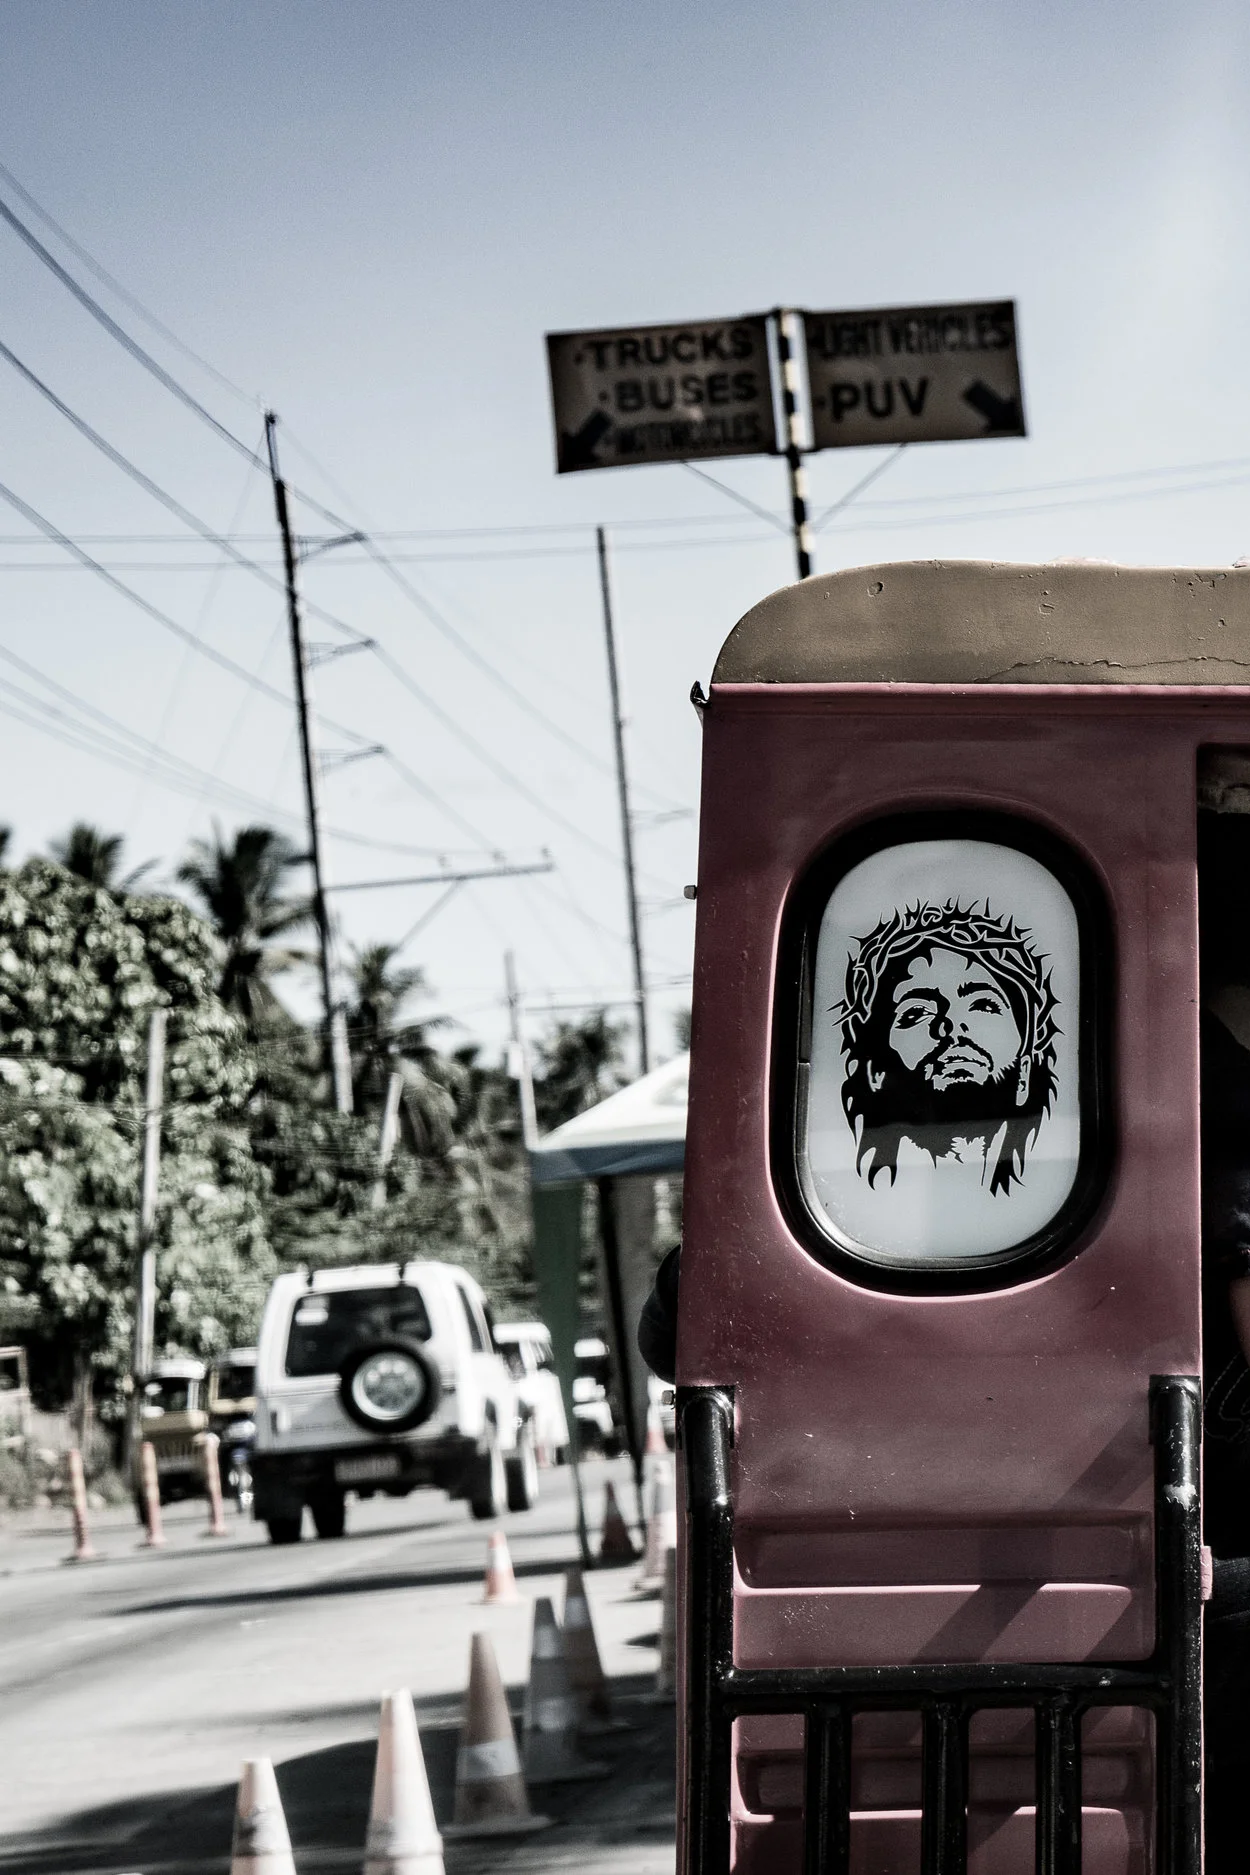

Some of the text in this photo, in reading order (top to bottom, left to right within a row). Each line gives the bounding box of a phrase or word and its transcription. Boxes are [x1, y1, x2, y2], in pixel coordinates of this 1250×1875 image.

[587, 327, 754, 369] TRUCKS
[616, 371, 757, 411] BUSES
[831, 378, 928, 421] PUV
